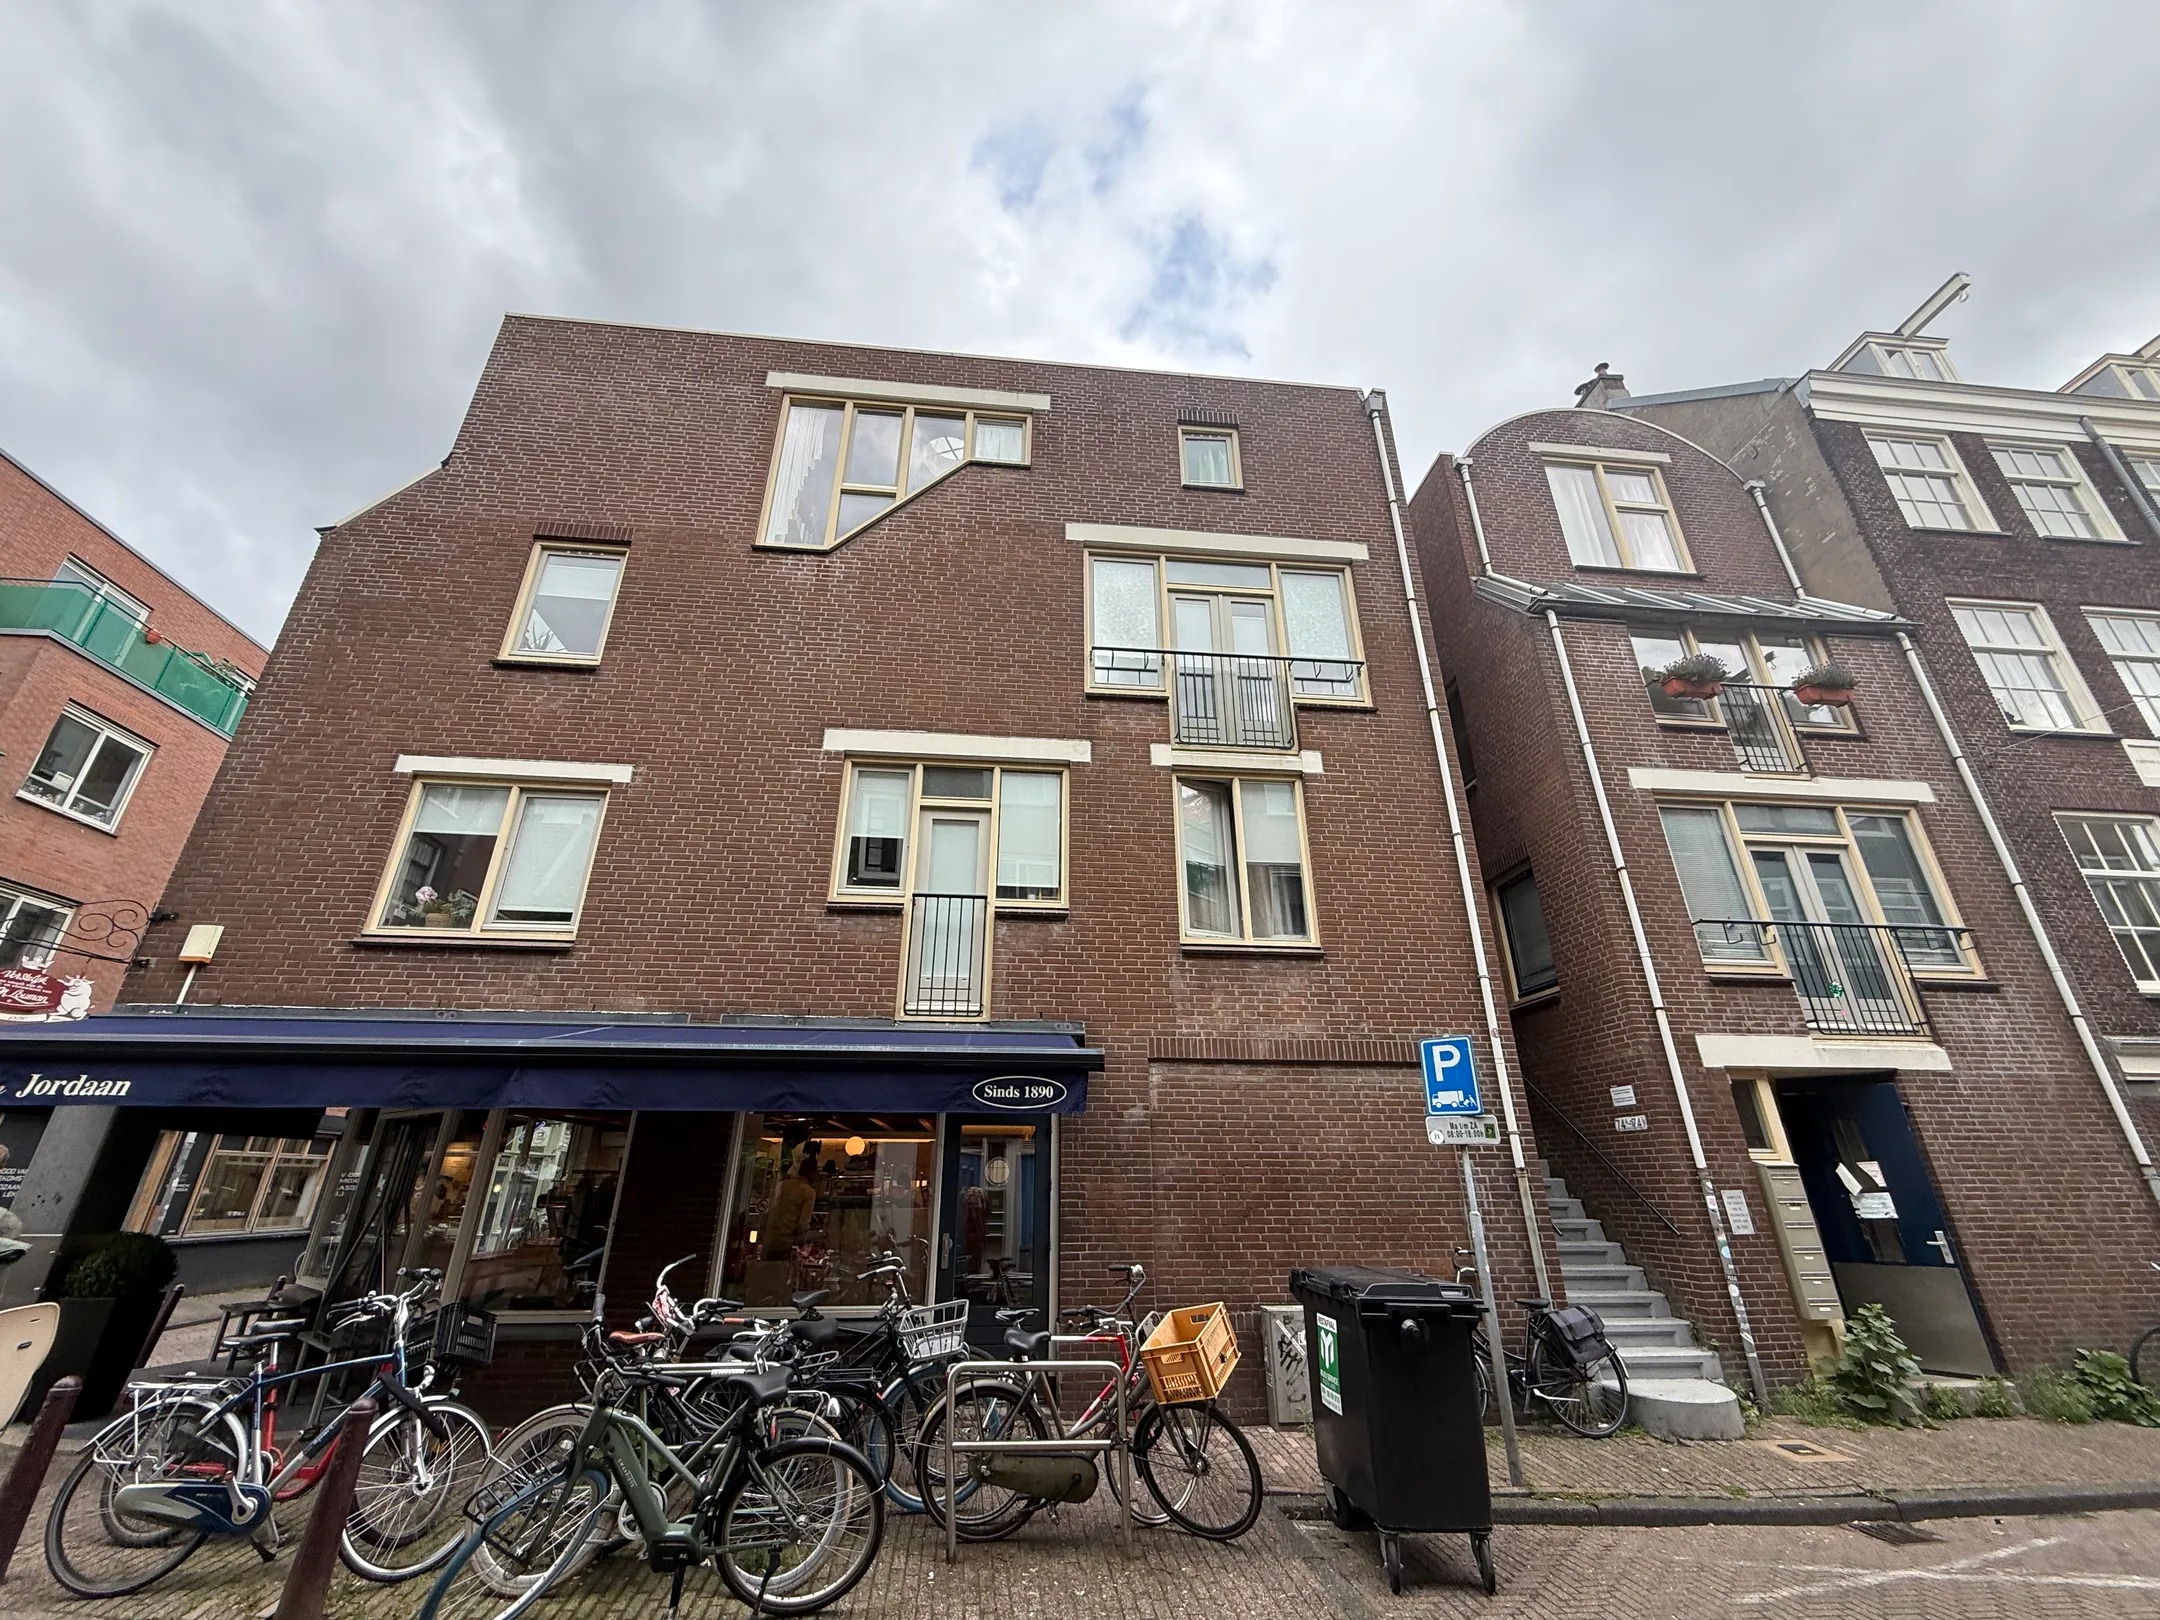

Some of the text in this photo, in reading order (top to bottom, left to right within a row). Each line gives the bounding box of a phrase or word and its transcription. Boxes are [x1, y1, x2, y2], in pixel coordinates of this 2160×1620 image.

[1432, 1044, 1461, 1082] P
[15, 1073, 132, 1098] Jordaan
[984, 1085, 1054, 1098] Sinds 1890
